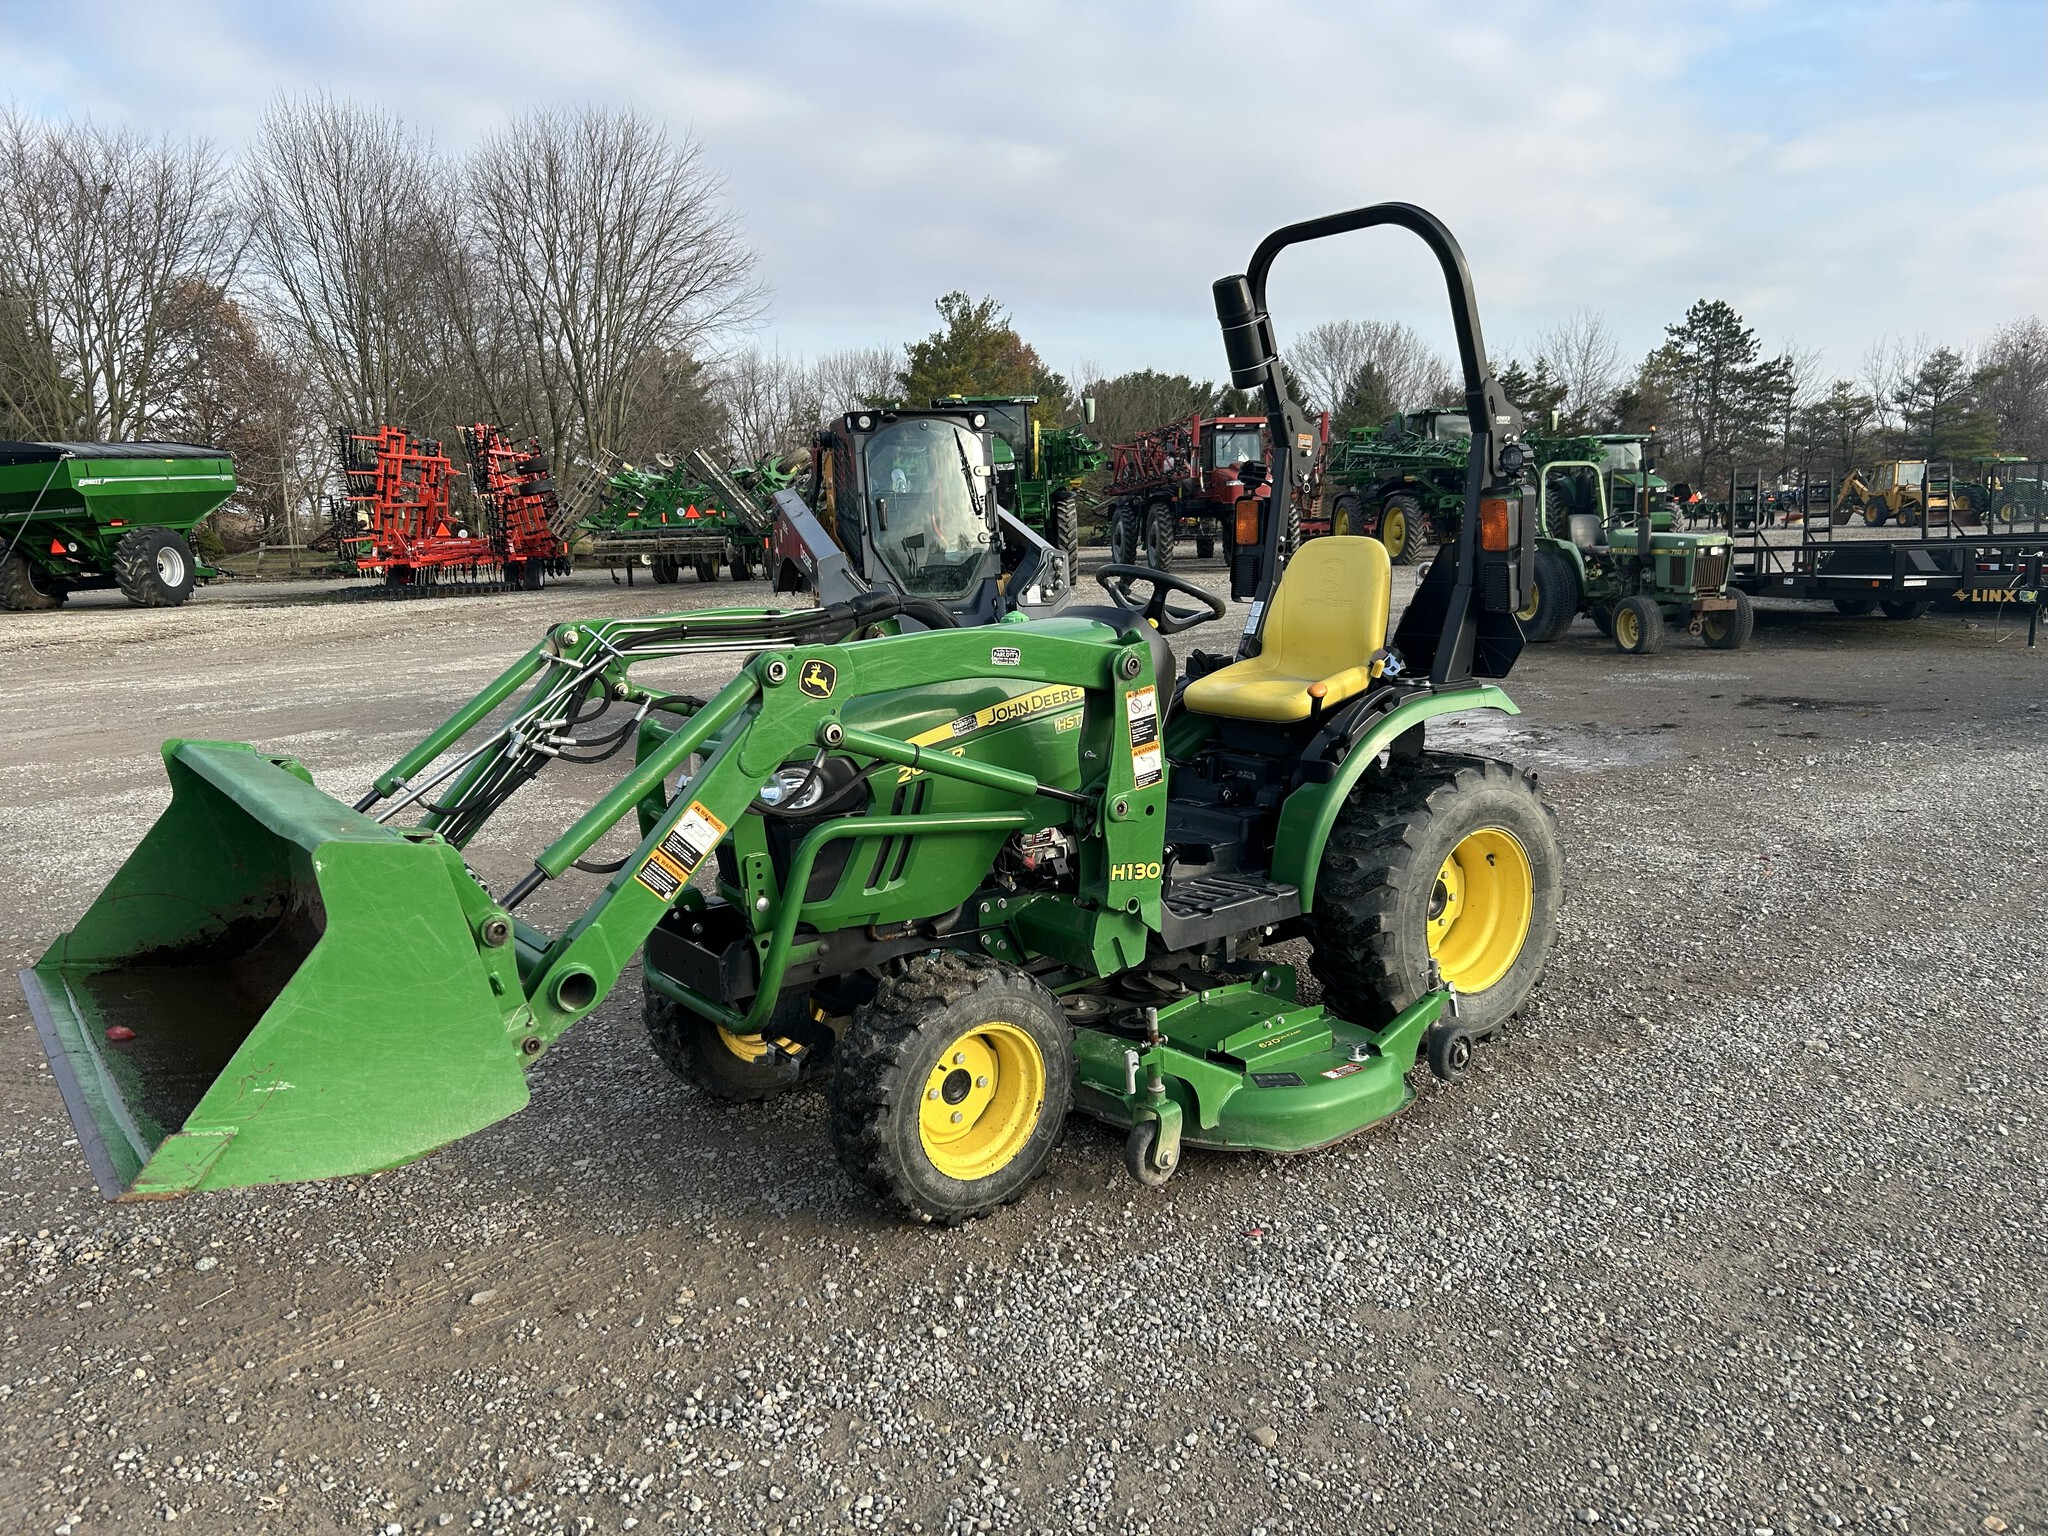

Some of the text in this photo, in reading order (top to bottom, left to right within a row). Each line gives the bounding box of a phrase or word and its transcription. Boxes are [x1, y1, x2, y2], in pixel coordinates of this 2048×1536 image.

[1972, 589, 2017, 602] LINX
[1132, 685, 1154, 697] WARNING
[987, 688, 1081, 725] JOHN DEERE
[1057, 713, 1082, 732] HST
[1137, 743, 1160, 756] WARNING
[699, 807, 723, 831] WARNING
[660, 857, 684, 881] WARNING
[1110, 861, 1161, 881] H130
